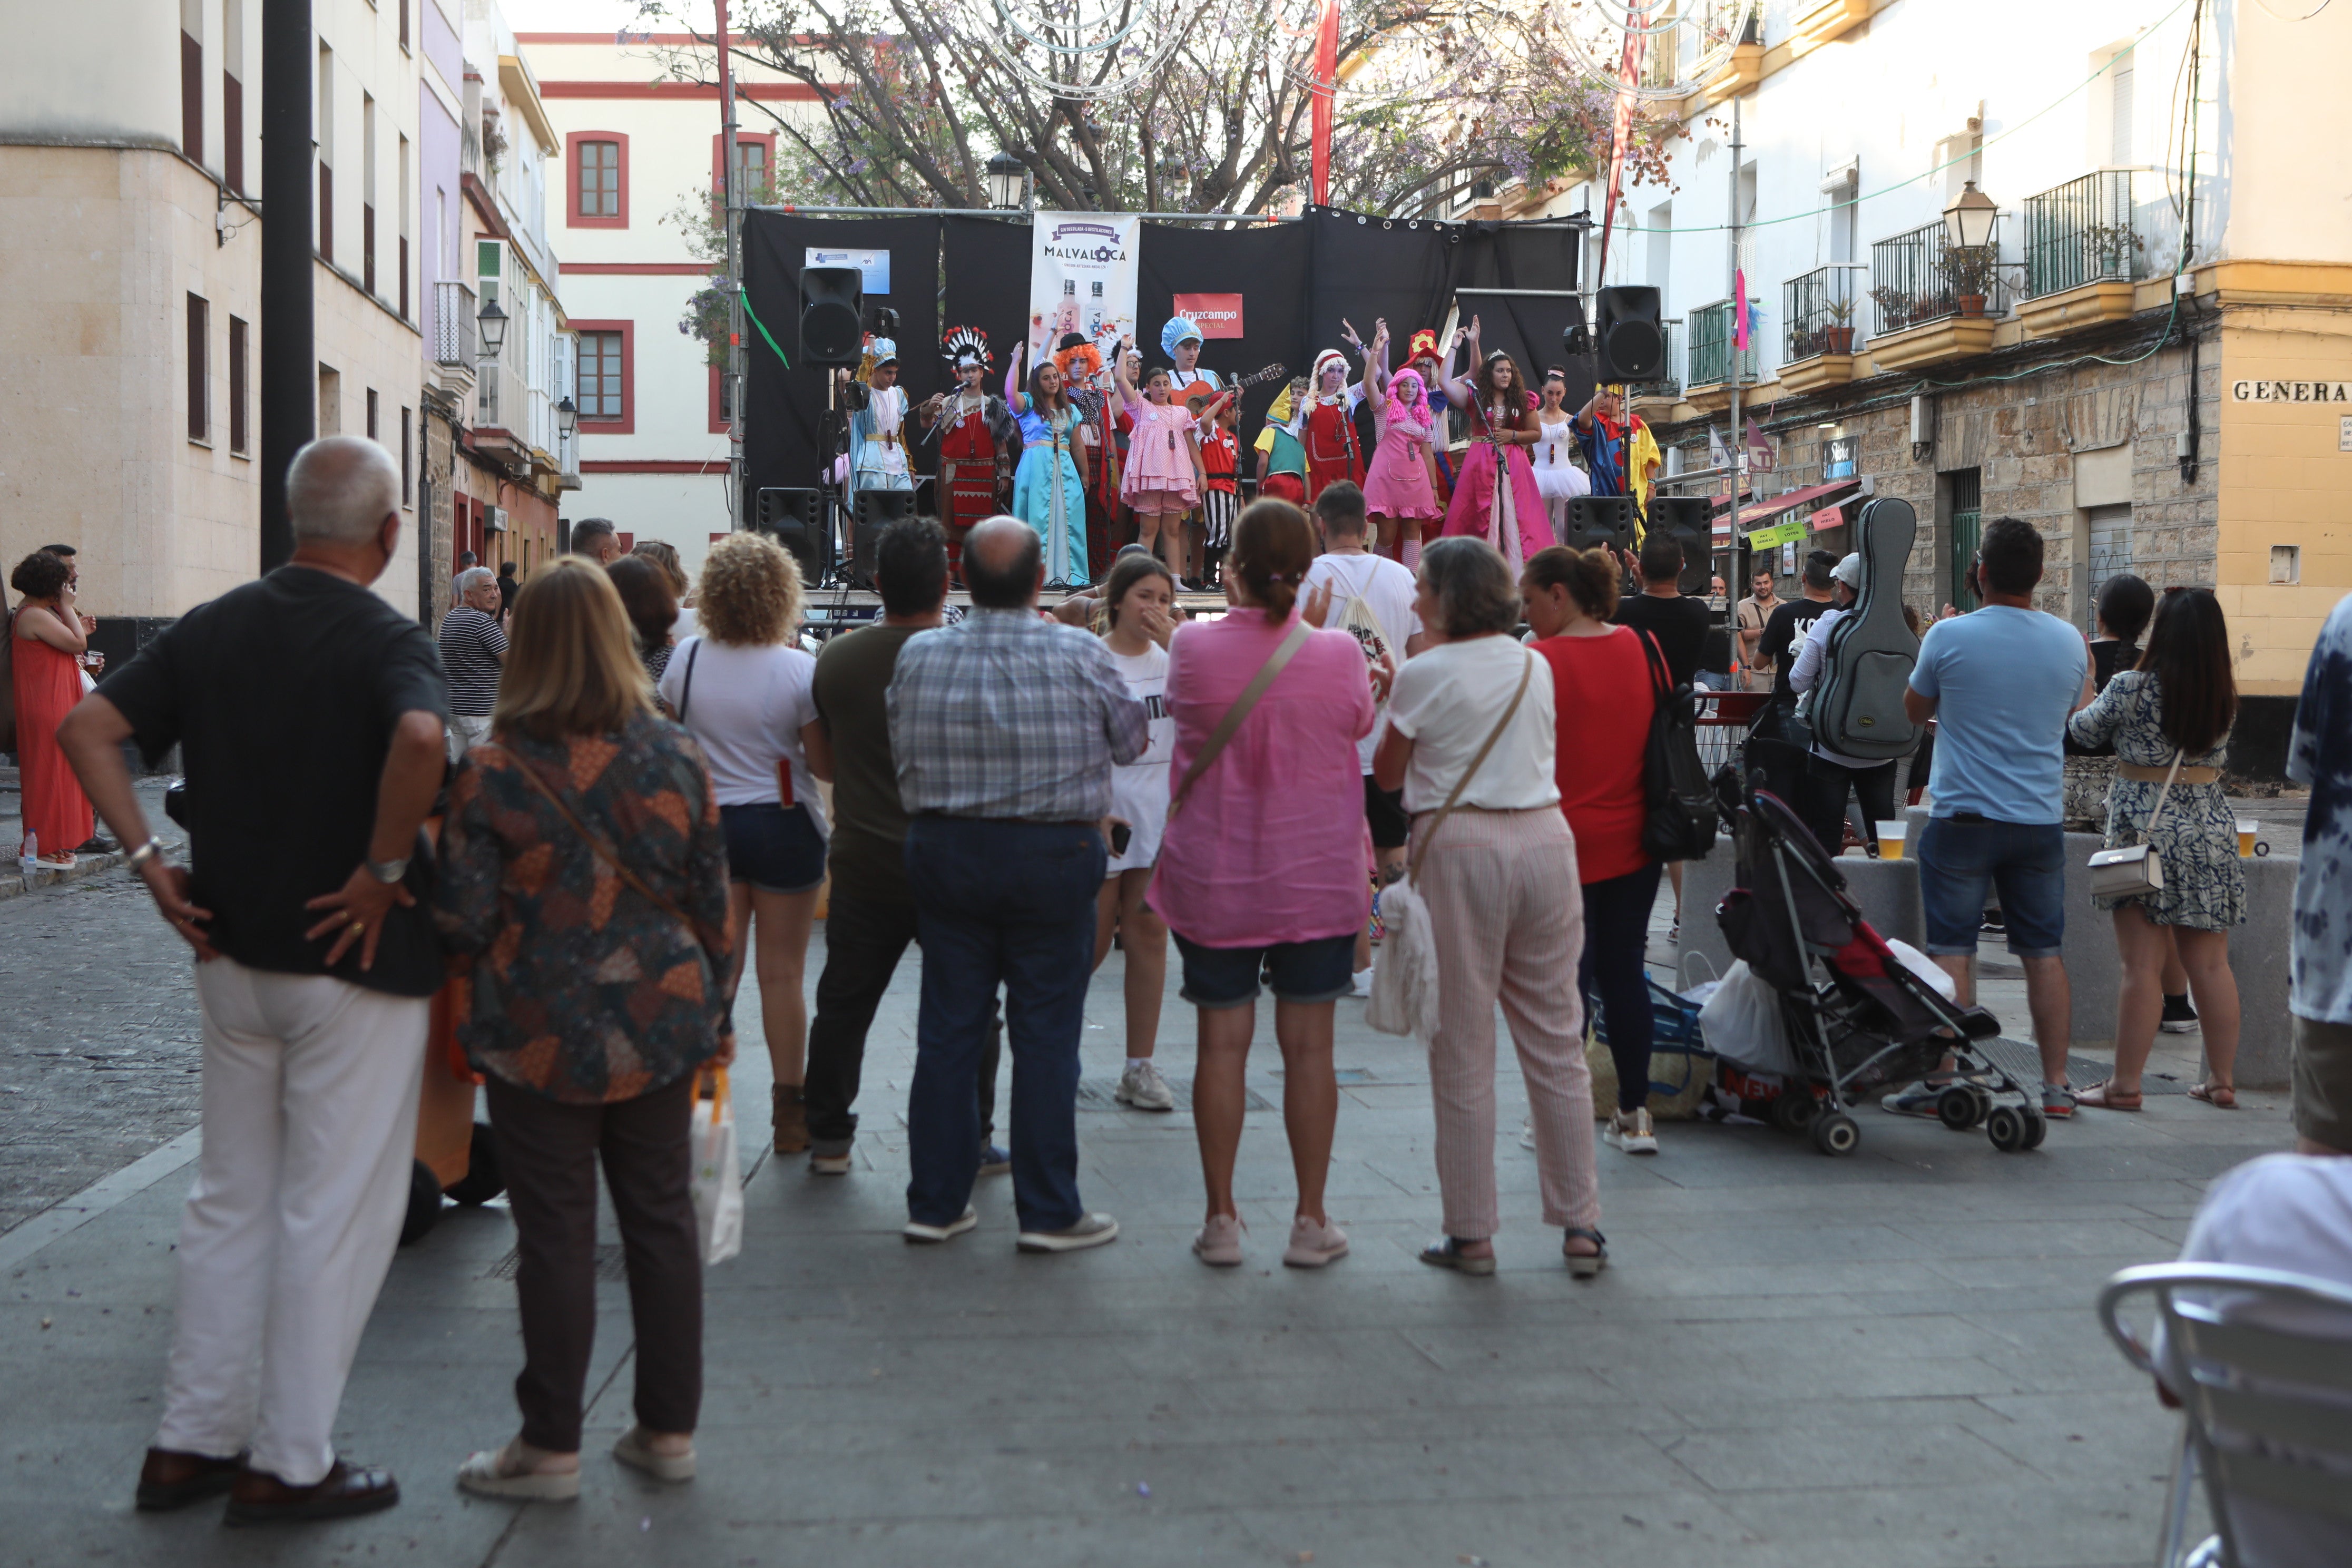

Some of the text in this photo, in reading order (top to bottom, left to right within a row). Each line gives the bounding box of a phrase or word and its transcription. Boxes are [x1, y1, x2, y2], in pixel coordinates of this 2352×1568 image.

[1044, 246, 1126, 261] MALVALOCA
[1179, 309, 1237, 321] Cruzcampo
[2234, 382, 2352, 401] GENERA
[1831, 442, 1848, 463] Shisha
